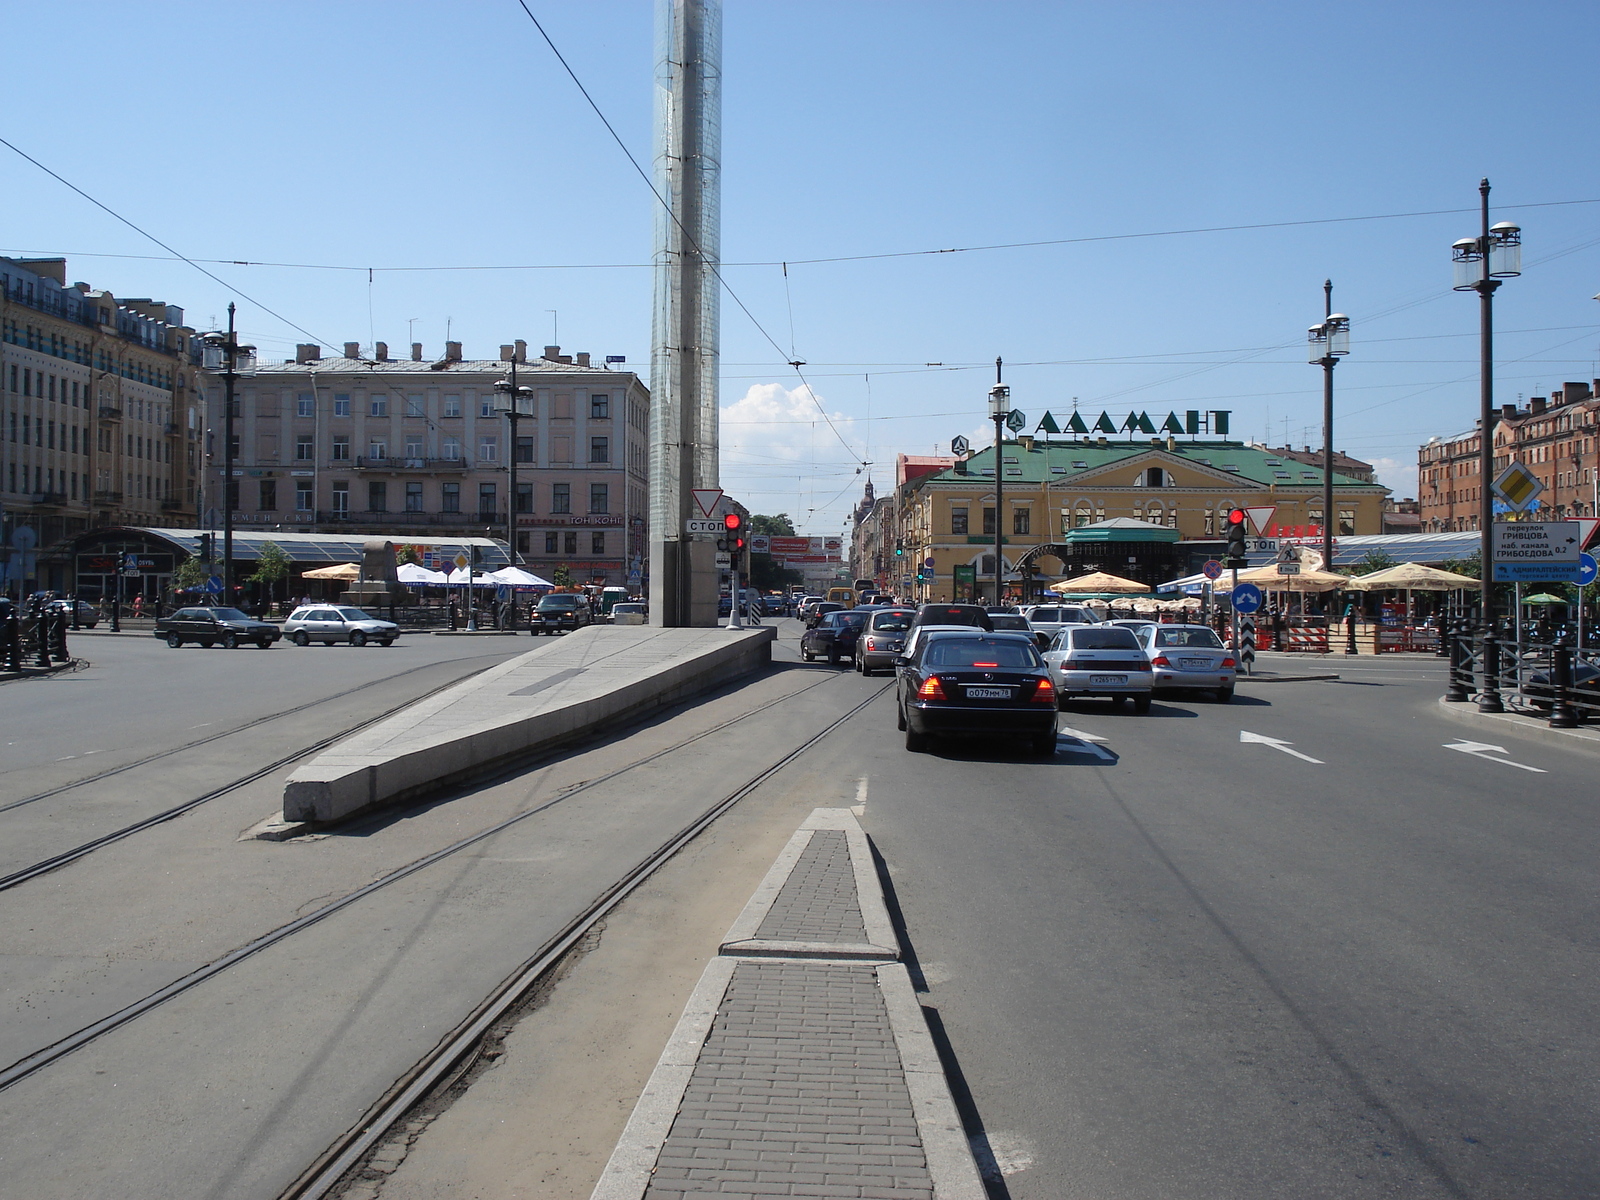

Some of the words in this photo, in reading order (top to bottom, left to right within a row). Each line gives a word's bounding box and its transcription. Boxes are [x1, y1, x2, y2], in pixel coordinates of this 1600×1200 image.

[1034, 410, 1232, 434] АДАМАНТ
[690, 522, 724, 531] СТОП
[1502, 532, 1549, 540] ГРИВЦОВА
[1244, 541, 1276, 550] СТОП
[1496, 550, 1554, 558] ГРИБОЕДОВА
